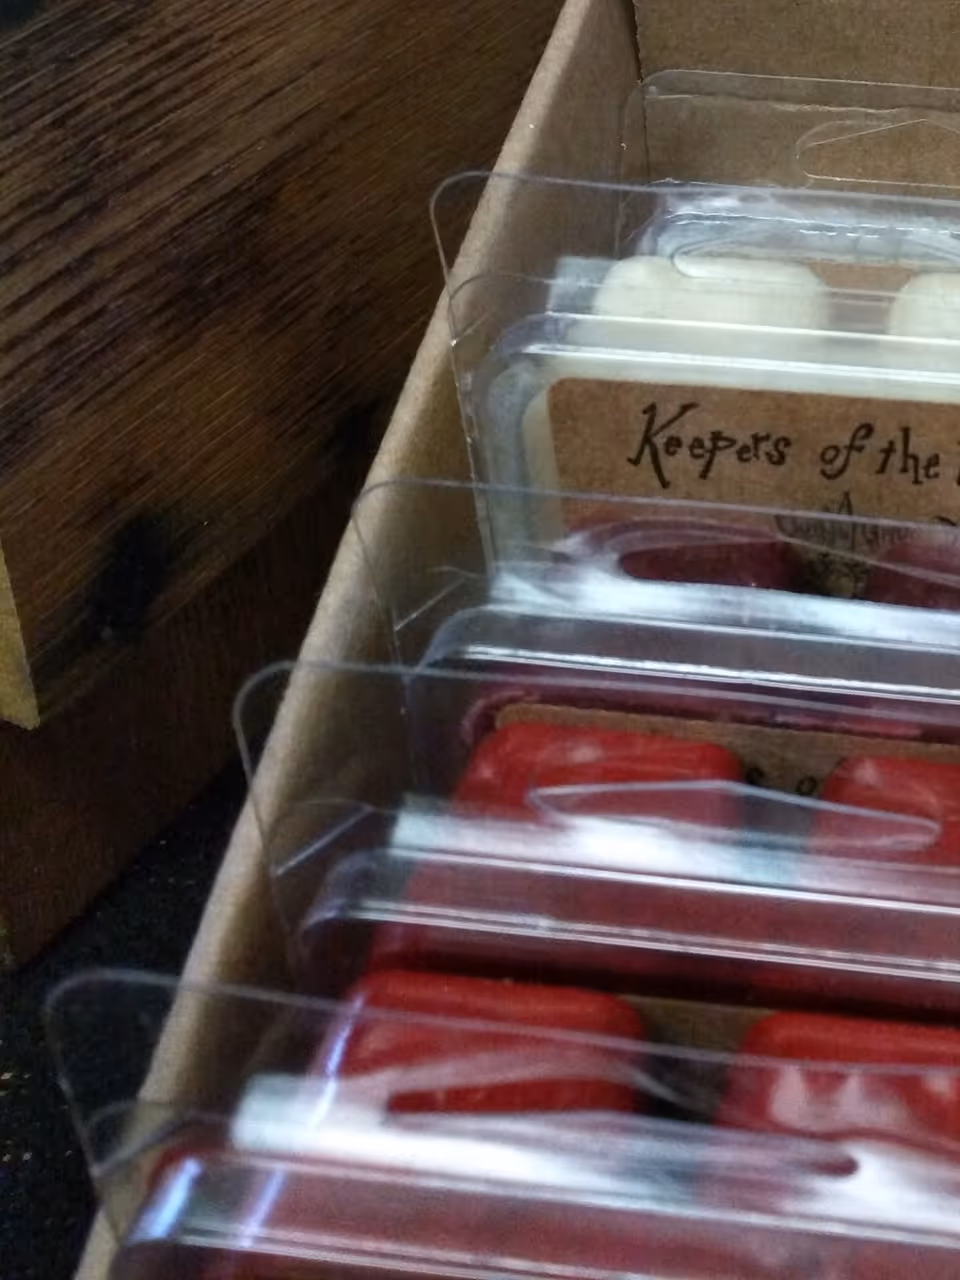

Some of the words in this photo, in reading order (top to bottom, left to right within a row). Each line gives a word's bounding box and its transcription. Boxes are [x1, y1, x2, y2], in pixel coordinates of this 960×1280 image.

[627, 402, 792, 489] Keepers
[820, 423, 874, 480] of
[876, 426, 940, 485] the
